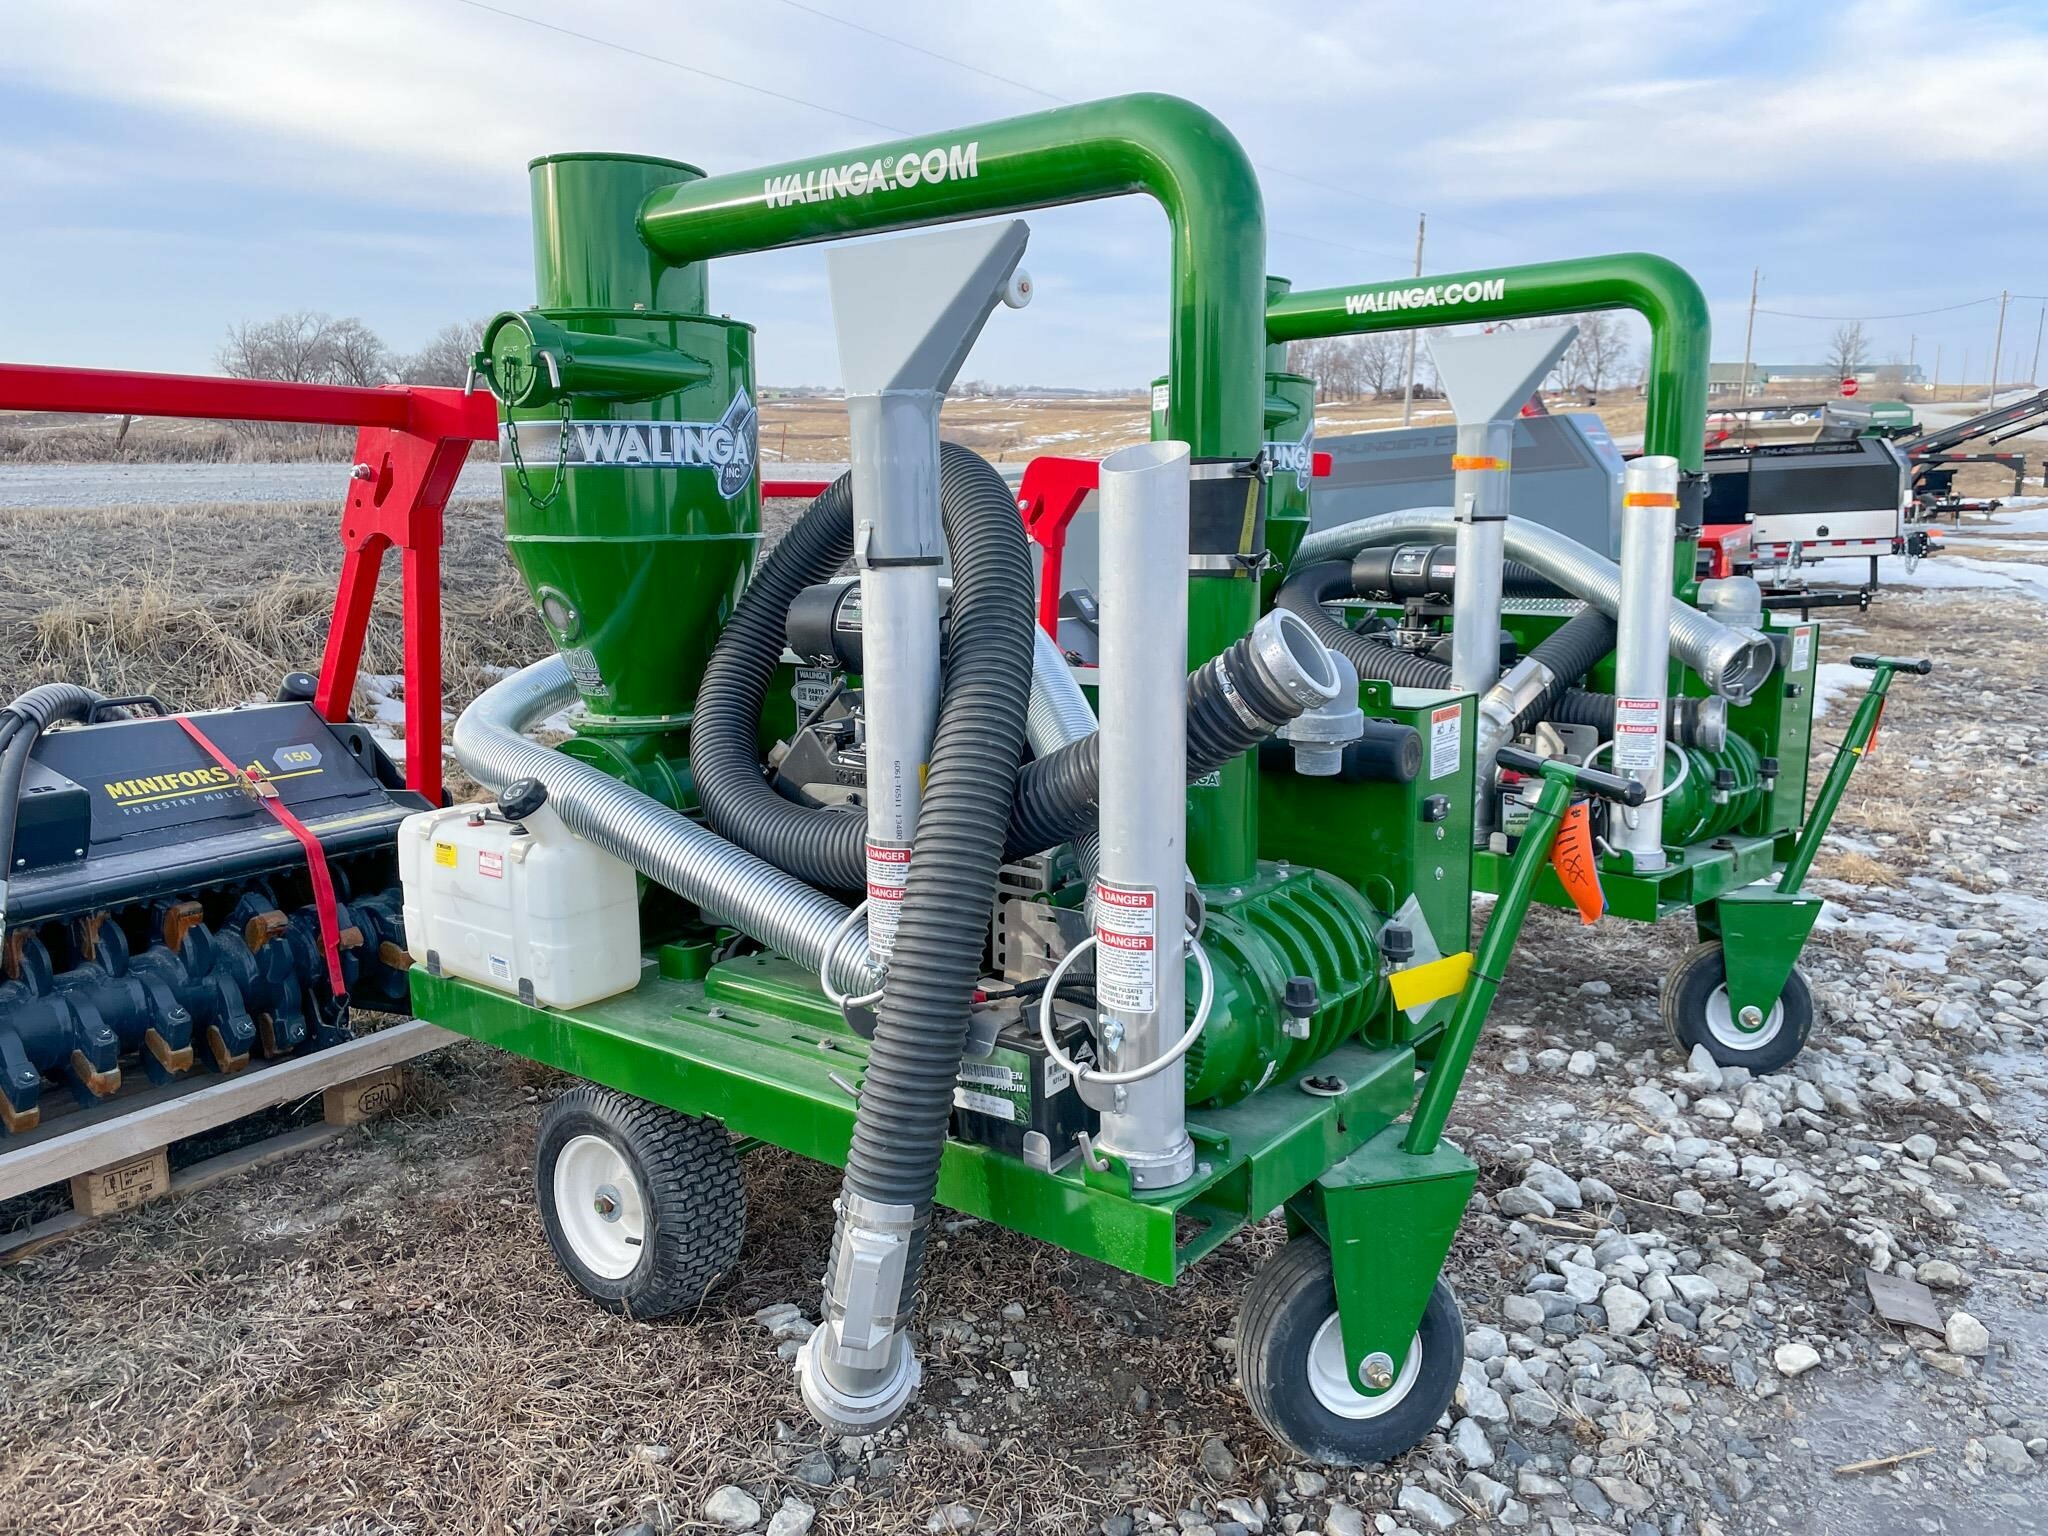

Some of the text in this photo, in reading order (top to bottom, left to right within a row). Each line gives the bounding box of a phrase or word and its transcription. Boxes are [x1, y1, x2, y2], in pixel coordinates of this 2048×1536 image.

[575, 424, 750, 465] WALINGA
[799, 669, 828, 681] WALINGA
[807, 687, 825, 696] PARTS
[282, 750, 313, 764] 150
[123, 797, 197, 816] FORESTRY
[870, 850, 906, 861] DANGER
[1104, 891, 1147, 906] DANGER
[1104, 933, 1147, 949] DANGER
